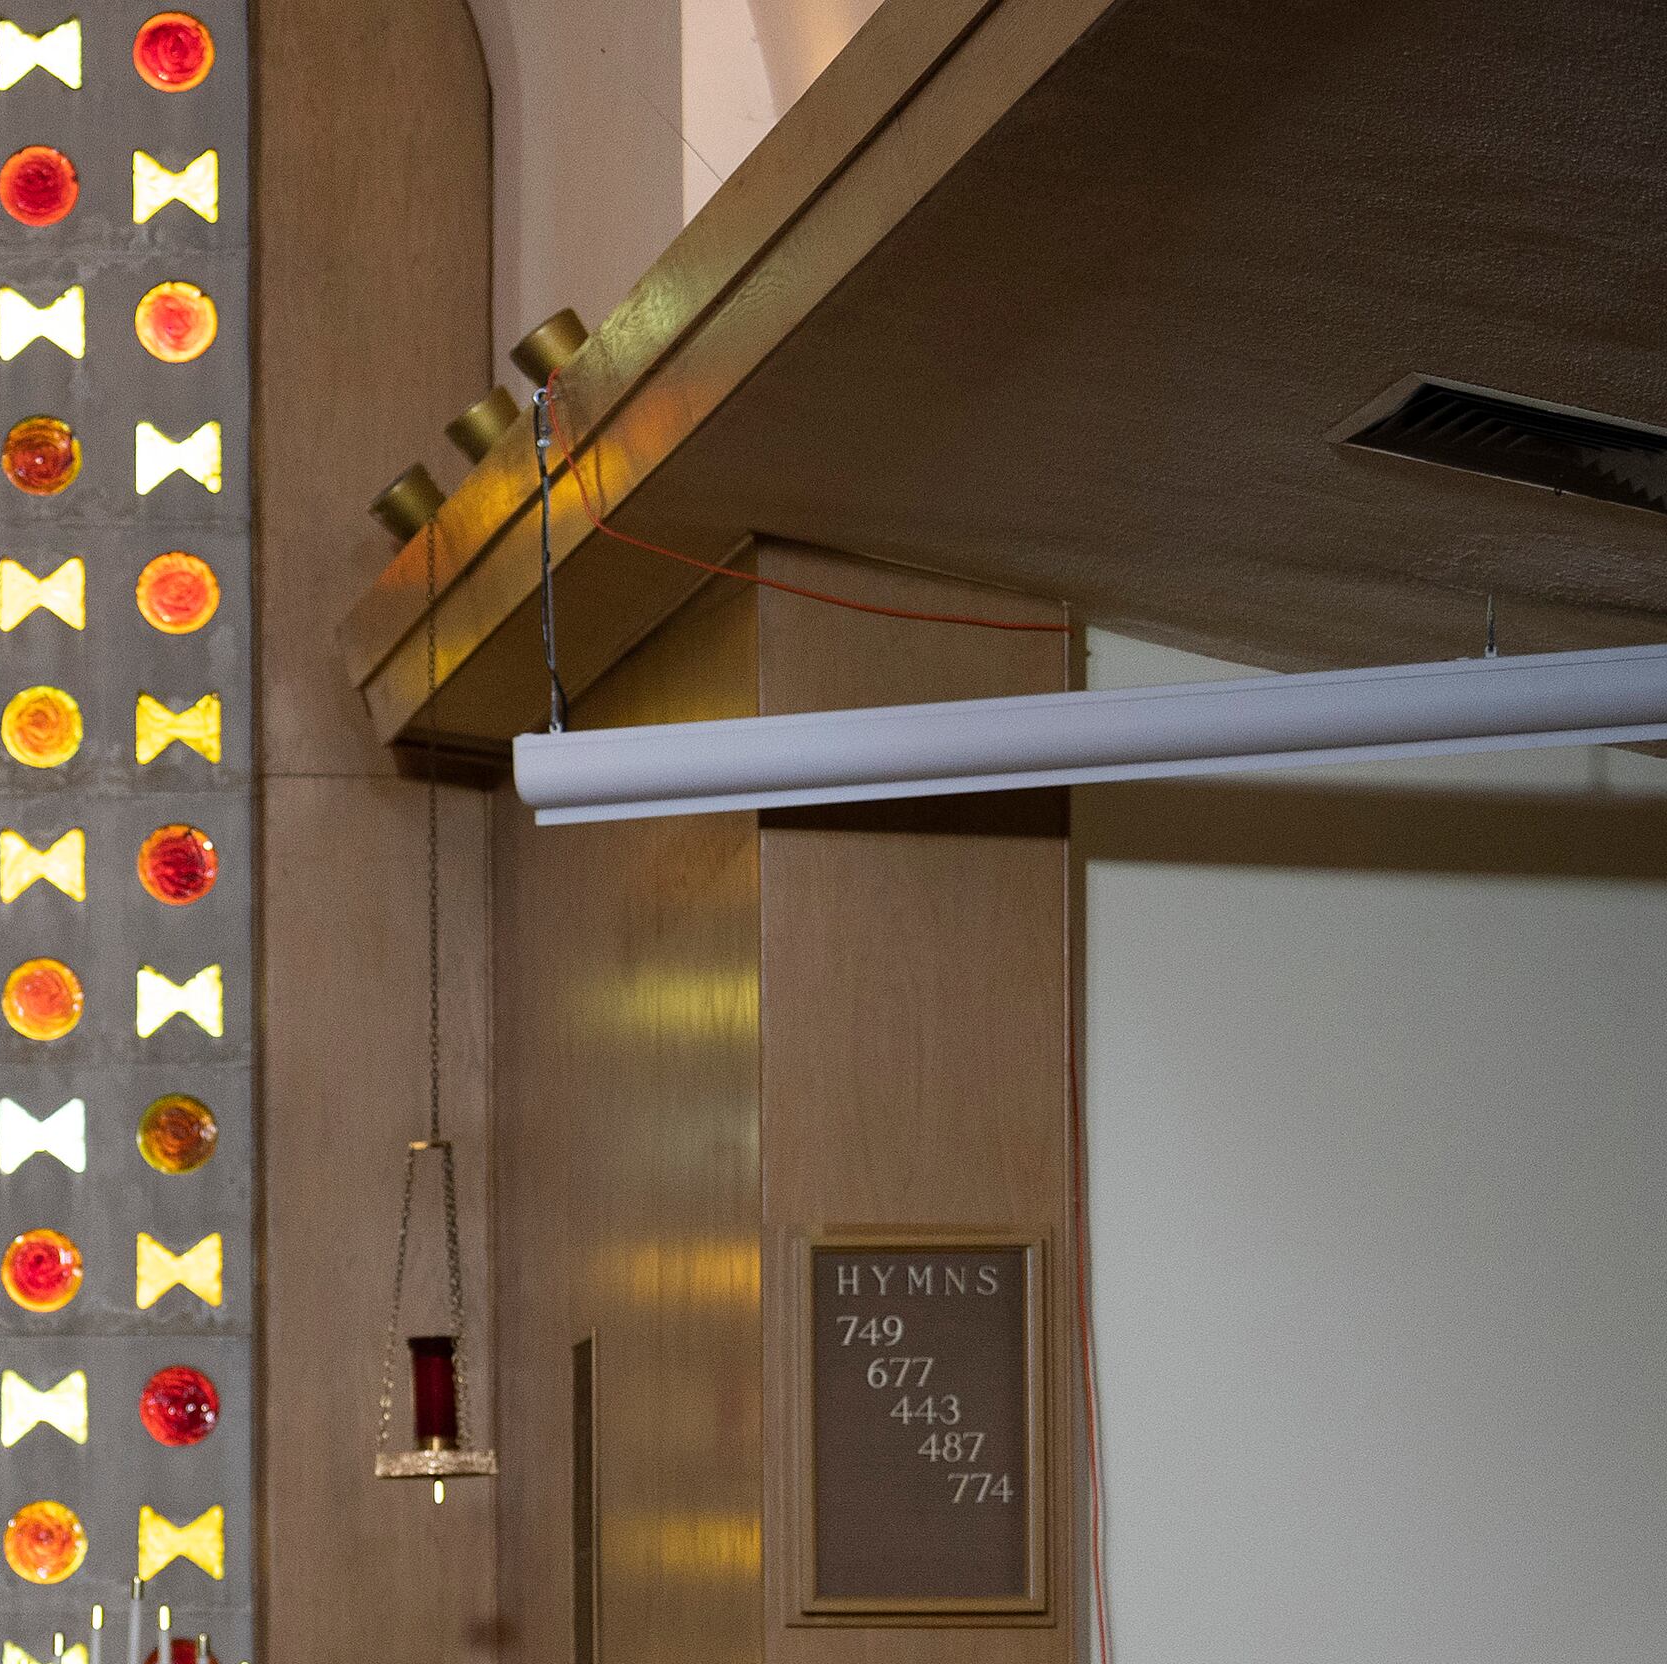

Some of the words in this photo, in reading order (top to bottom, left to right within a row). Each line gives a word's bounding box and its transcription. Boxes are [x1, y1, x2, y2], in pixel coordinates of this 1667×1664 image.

[836, 1265, 1000, 1296] HYMNS
[836, 1315, 904, 1347] 749
[867, 1356, 935, 1389] 677
[889, 1393, 961, 1426] 443
[917, 1431, 985, 1463] 487
[946, 1472, 1013, 1504] 774
